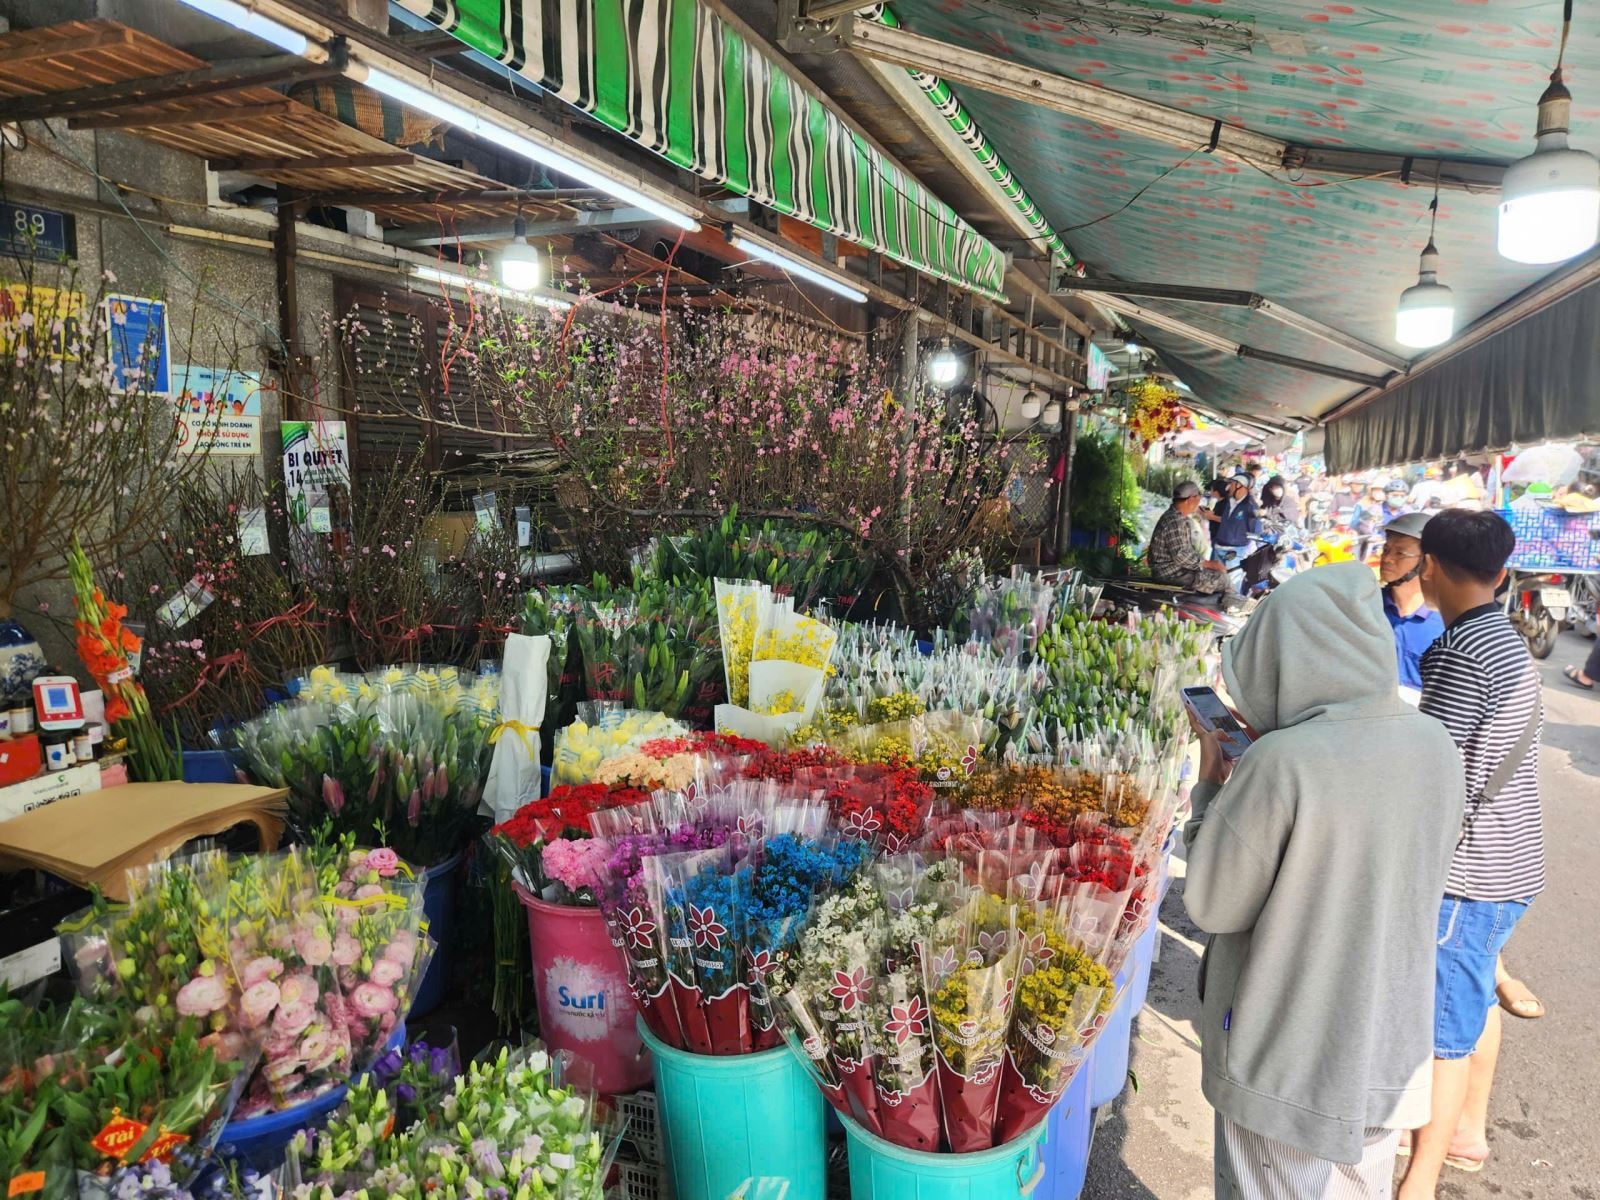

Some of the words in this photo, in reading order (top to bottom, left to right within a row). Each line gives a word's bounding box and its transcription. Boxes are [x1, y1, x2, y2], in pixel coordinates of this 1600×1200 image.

[15, 210, 45, 235] 89
[210, 440, 229, 448] ỘNG
[104, 1126, 135, 1147] Tài
